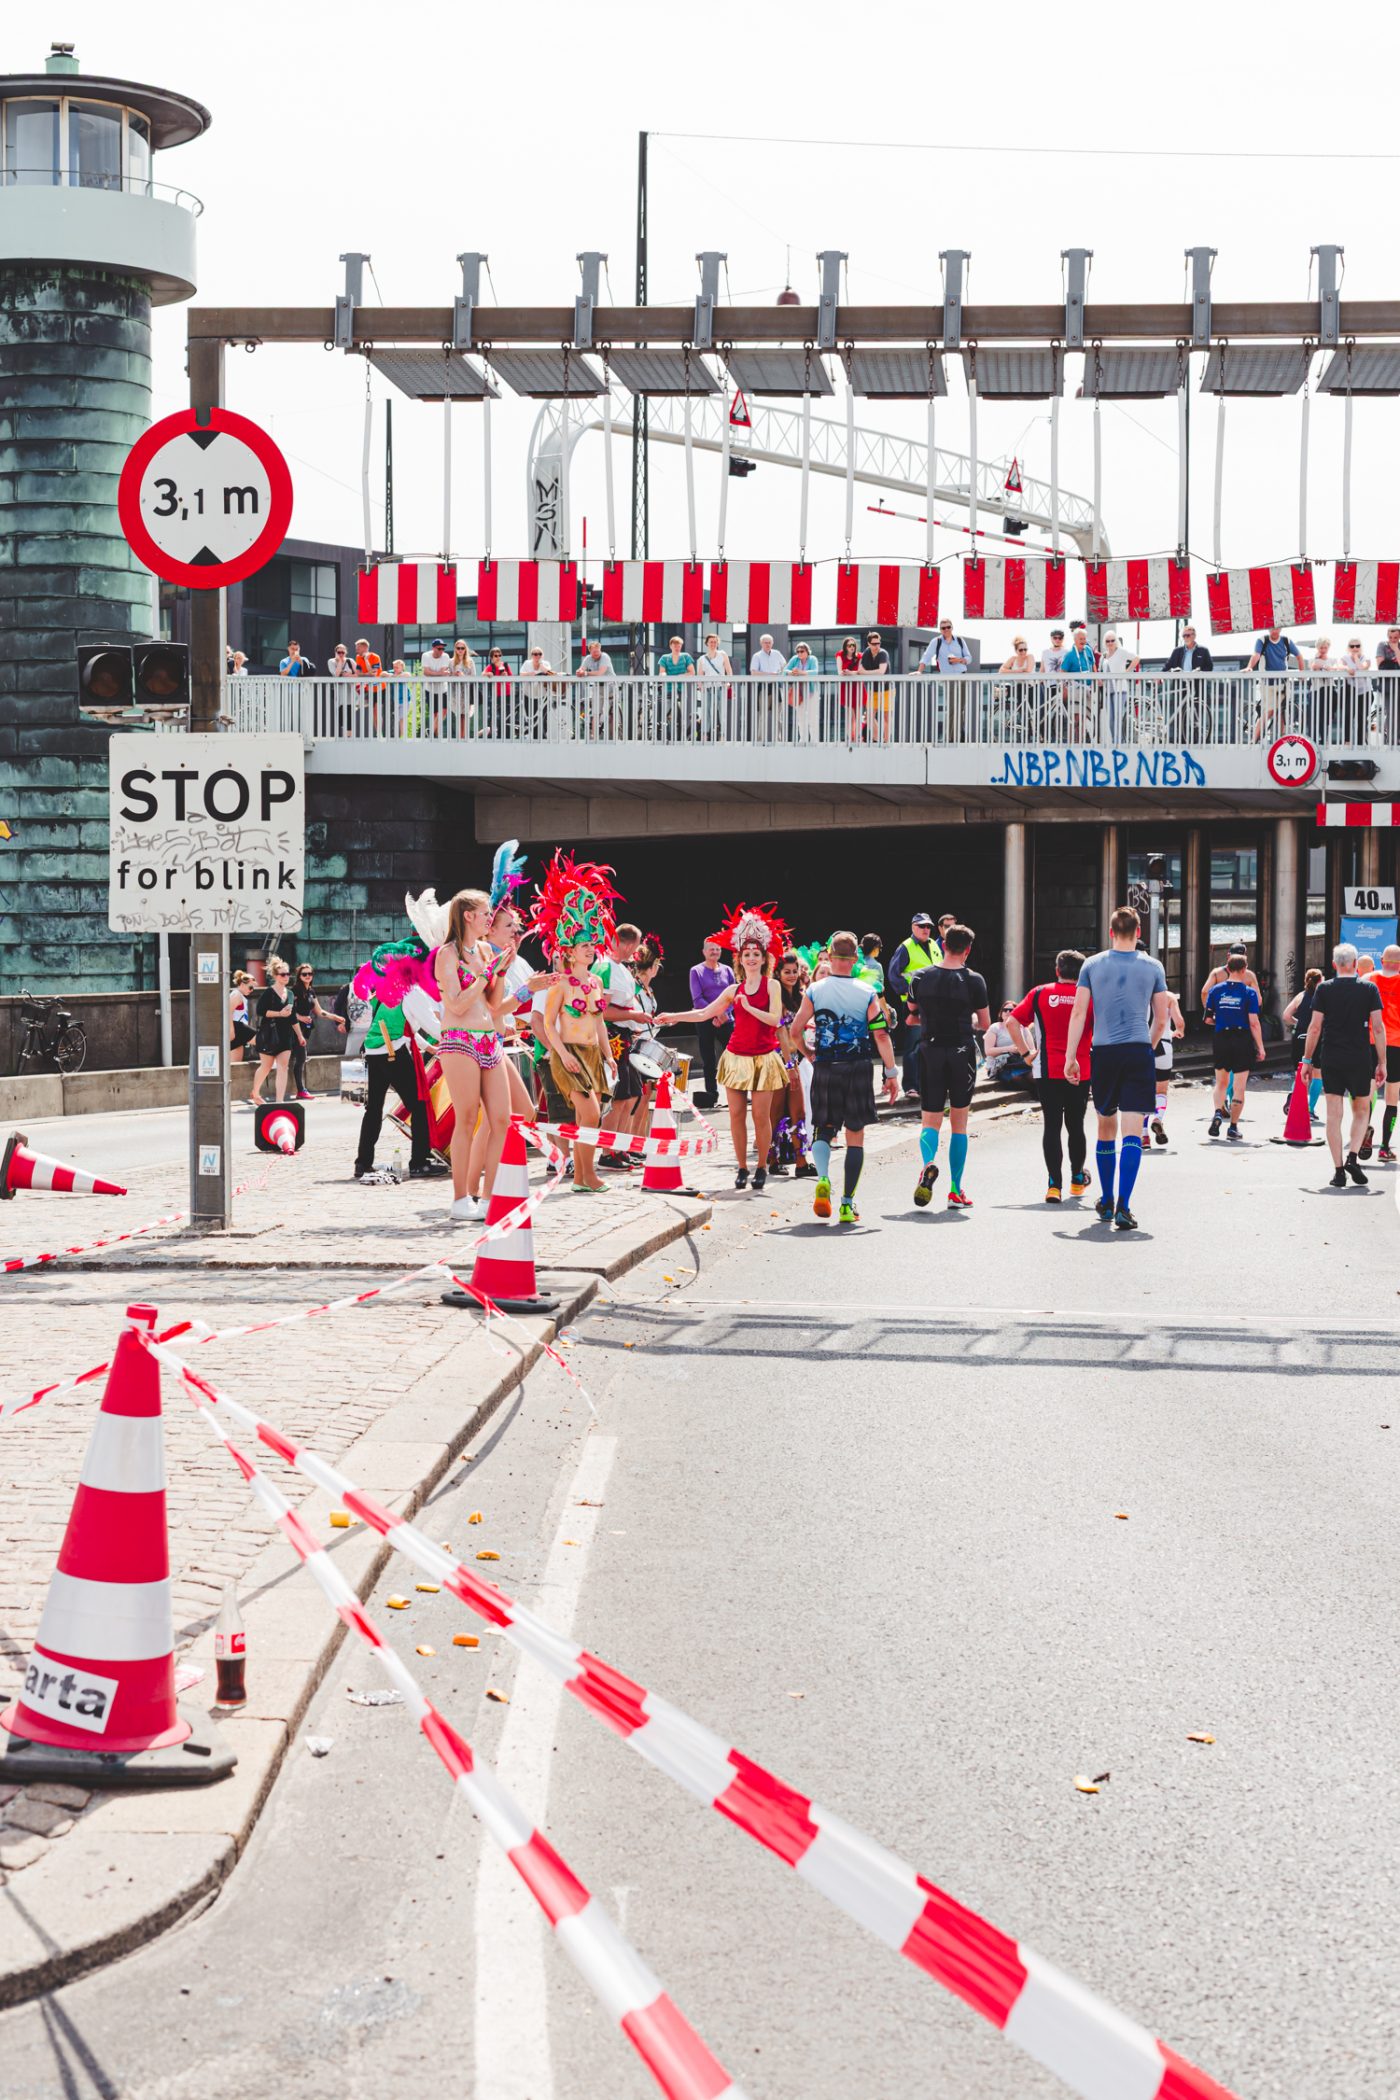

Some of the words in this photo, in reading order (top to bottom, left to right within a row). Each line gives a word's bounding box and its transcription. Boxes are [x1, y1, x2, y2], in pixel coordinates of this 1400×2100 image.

[153, 477, 204, 521] 3,1
[223, 486, 259, 514] m
[1295, 757, 1307, 767] m
[119, 769, 296, 822] STOP
[117, 860, 177, 890] for
[195, 860, 296, 890] blink
[1354, 890, 1380, 911] 40
[1380, 903, 1393, 911] KM
[25, 1664, 107, 1720] arta
